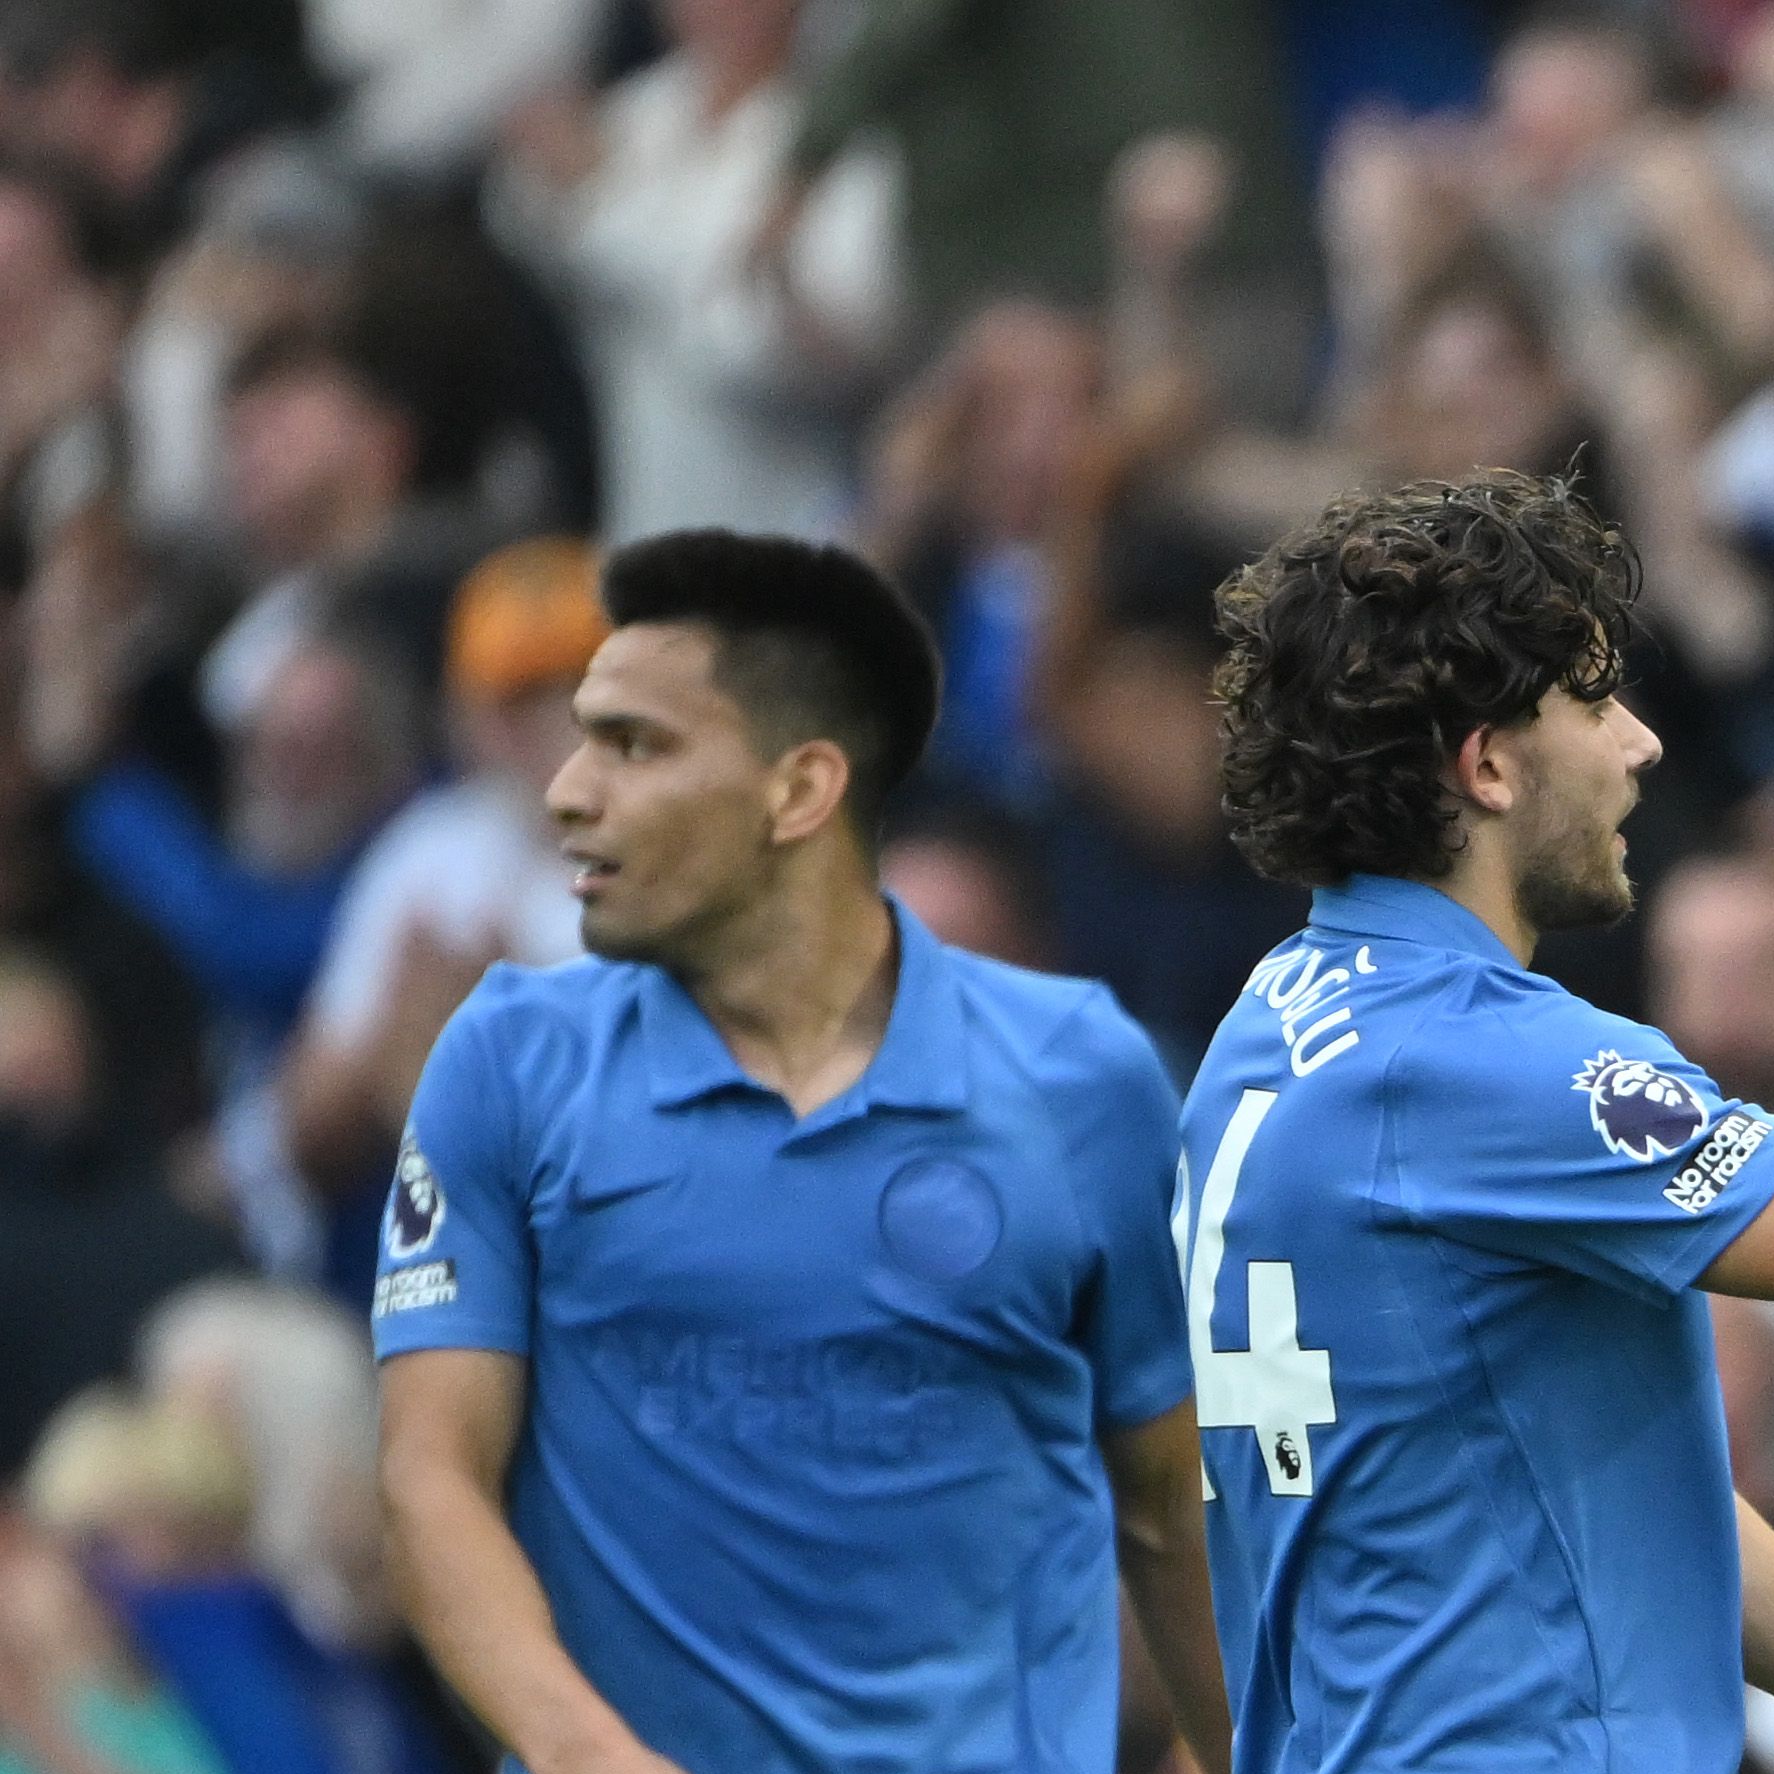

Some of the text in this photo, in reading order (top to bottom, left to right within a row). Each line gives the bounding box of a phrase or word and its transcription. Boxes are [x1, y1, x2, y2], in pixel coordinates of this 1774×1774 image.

[1663, 1115, 1750, 1207] No room
[1679, 1120, 1774, 1214] for racism
[1171, 1088, 1336, 1501] 4
